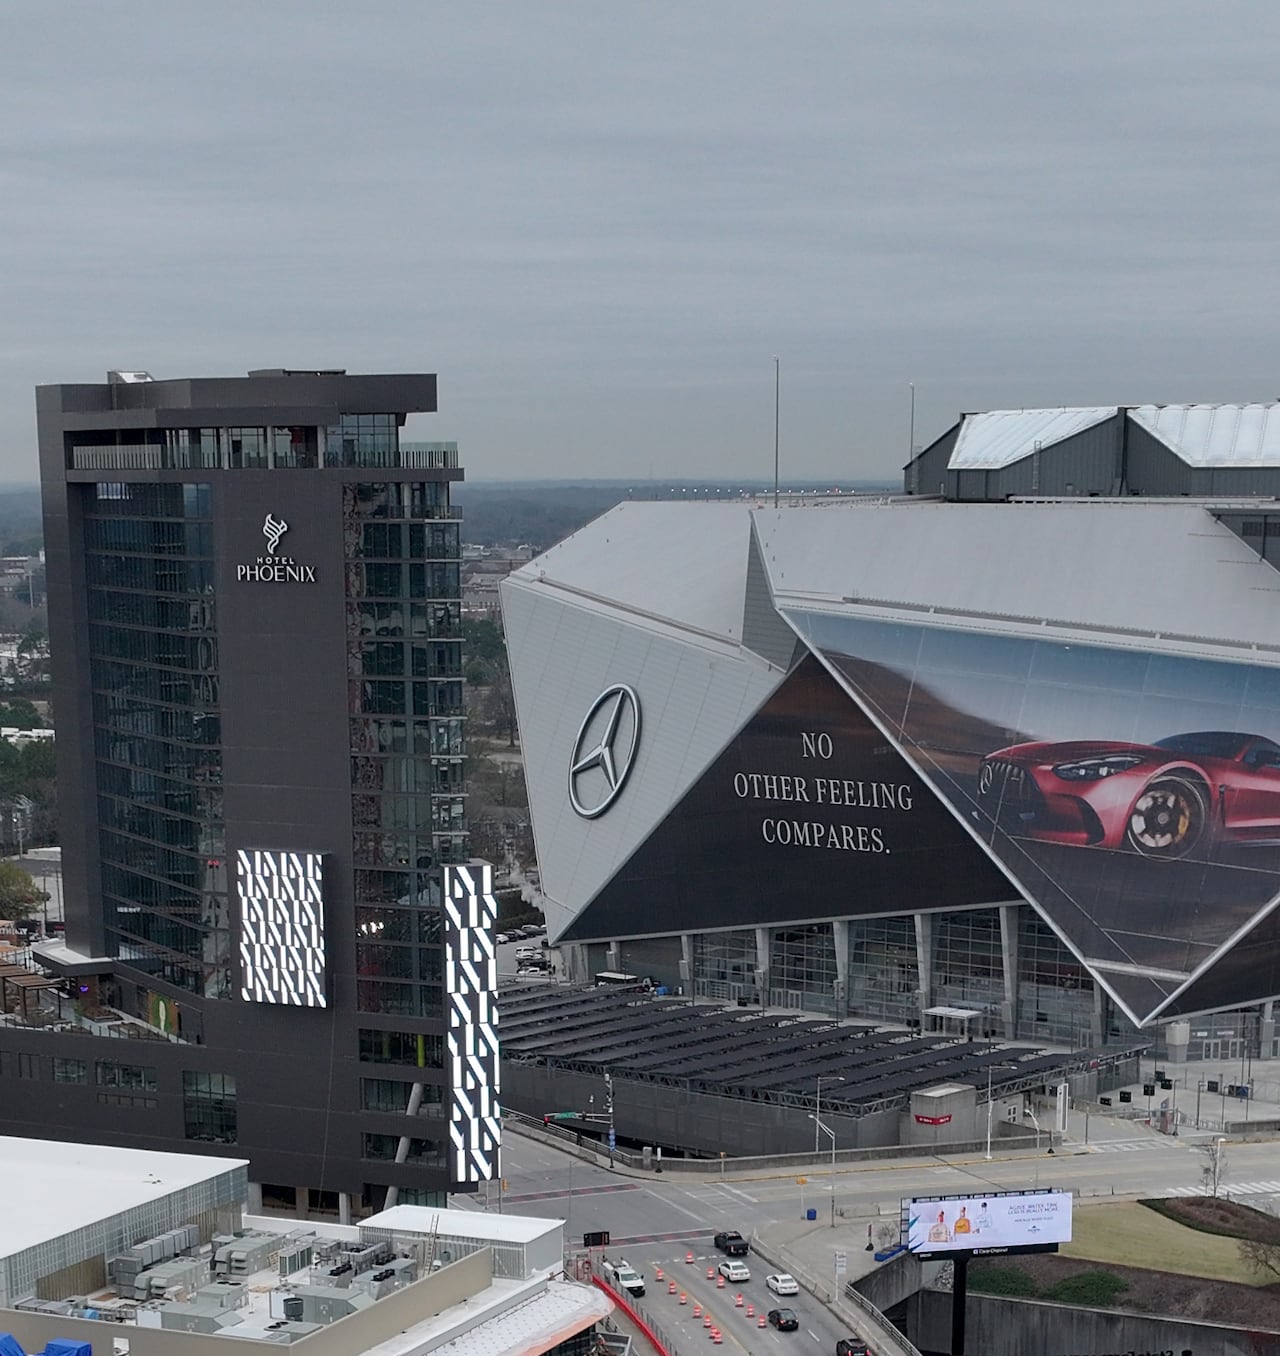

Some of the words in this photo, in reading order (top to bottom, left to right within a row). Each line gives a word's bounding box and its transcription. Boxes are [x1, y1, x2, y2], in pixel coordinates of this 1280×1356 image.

[237, 565, 315, 582] PHOENIX
[257, 557, 294, 565] HOTEL
[801, 732, 833, 759] NO
[734, 772, 810, 802] OTHER
[815, 778, 913, 810] FEELING
[762, 818, 892, 854] COMPARES.
